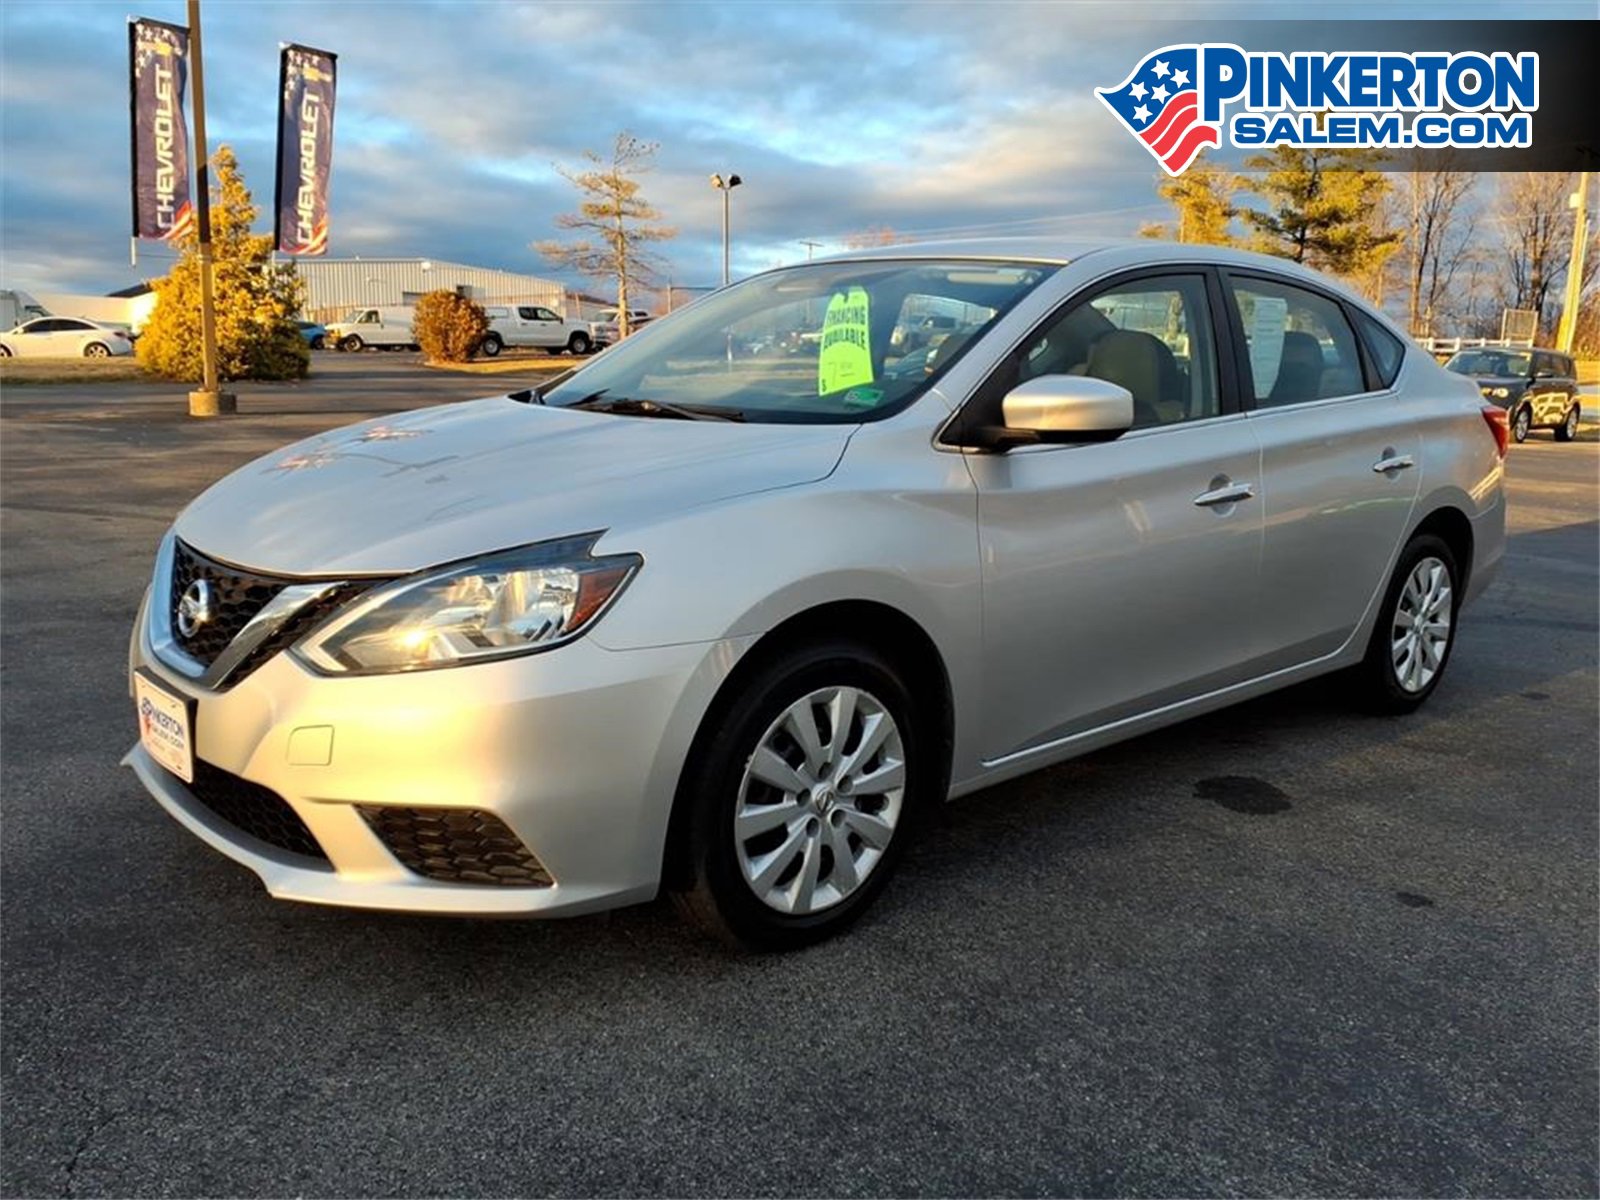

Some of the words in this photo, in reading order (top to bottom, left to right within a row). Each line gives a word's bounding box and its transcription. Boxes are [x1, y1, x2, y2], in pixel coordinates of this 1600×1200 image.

[155, 63, 175, 229] CHEVROLET
[297, 88, 320, 244] CHEVROLET
[823, 328, 866, 351] AVAILABLE
[827, 306, 866, 326] FINANCING
